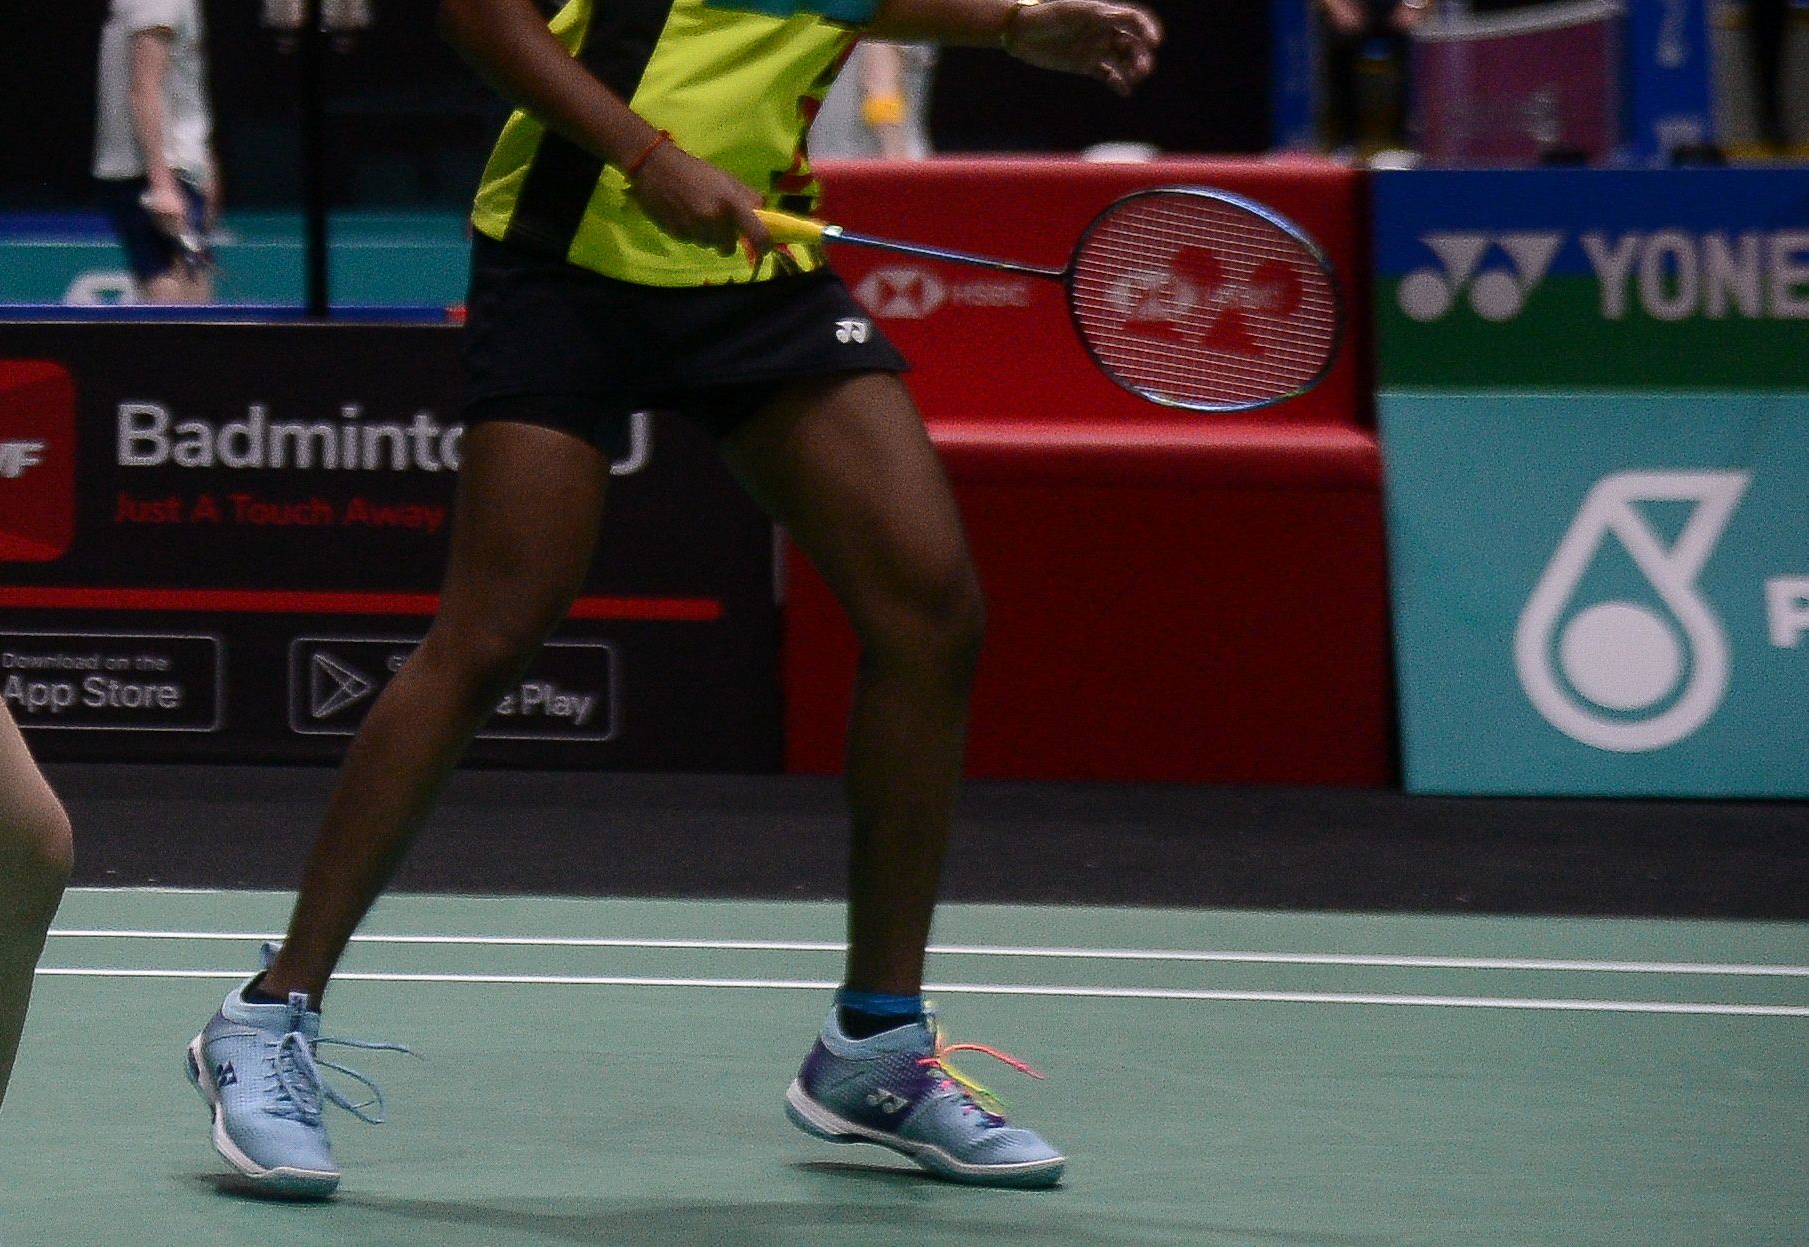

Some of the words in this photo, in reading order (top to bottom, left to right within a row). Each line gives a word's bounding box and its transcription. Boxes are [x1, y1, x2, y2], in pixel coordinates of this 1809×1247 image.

[114, 490, 183, 525] Just
[192, 493, 223, 524] A
[231, 492, 338, 527] Touch
[344, 495, 448, 534] Away
[1, 652, 100, 670] Download
[105, 655, 129, 671] on
[136, 654, 170, 672] the
[3, 674, 76, 714] App
[82, 676, 183, 709] Store
[520, 682, 593, 726] Play
